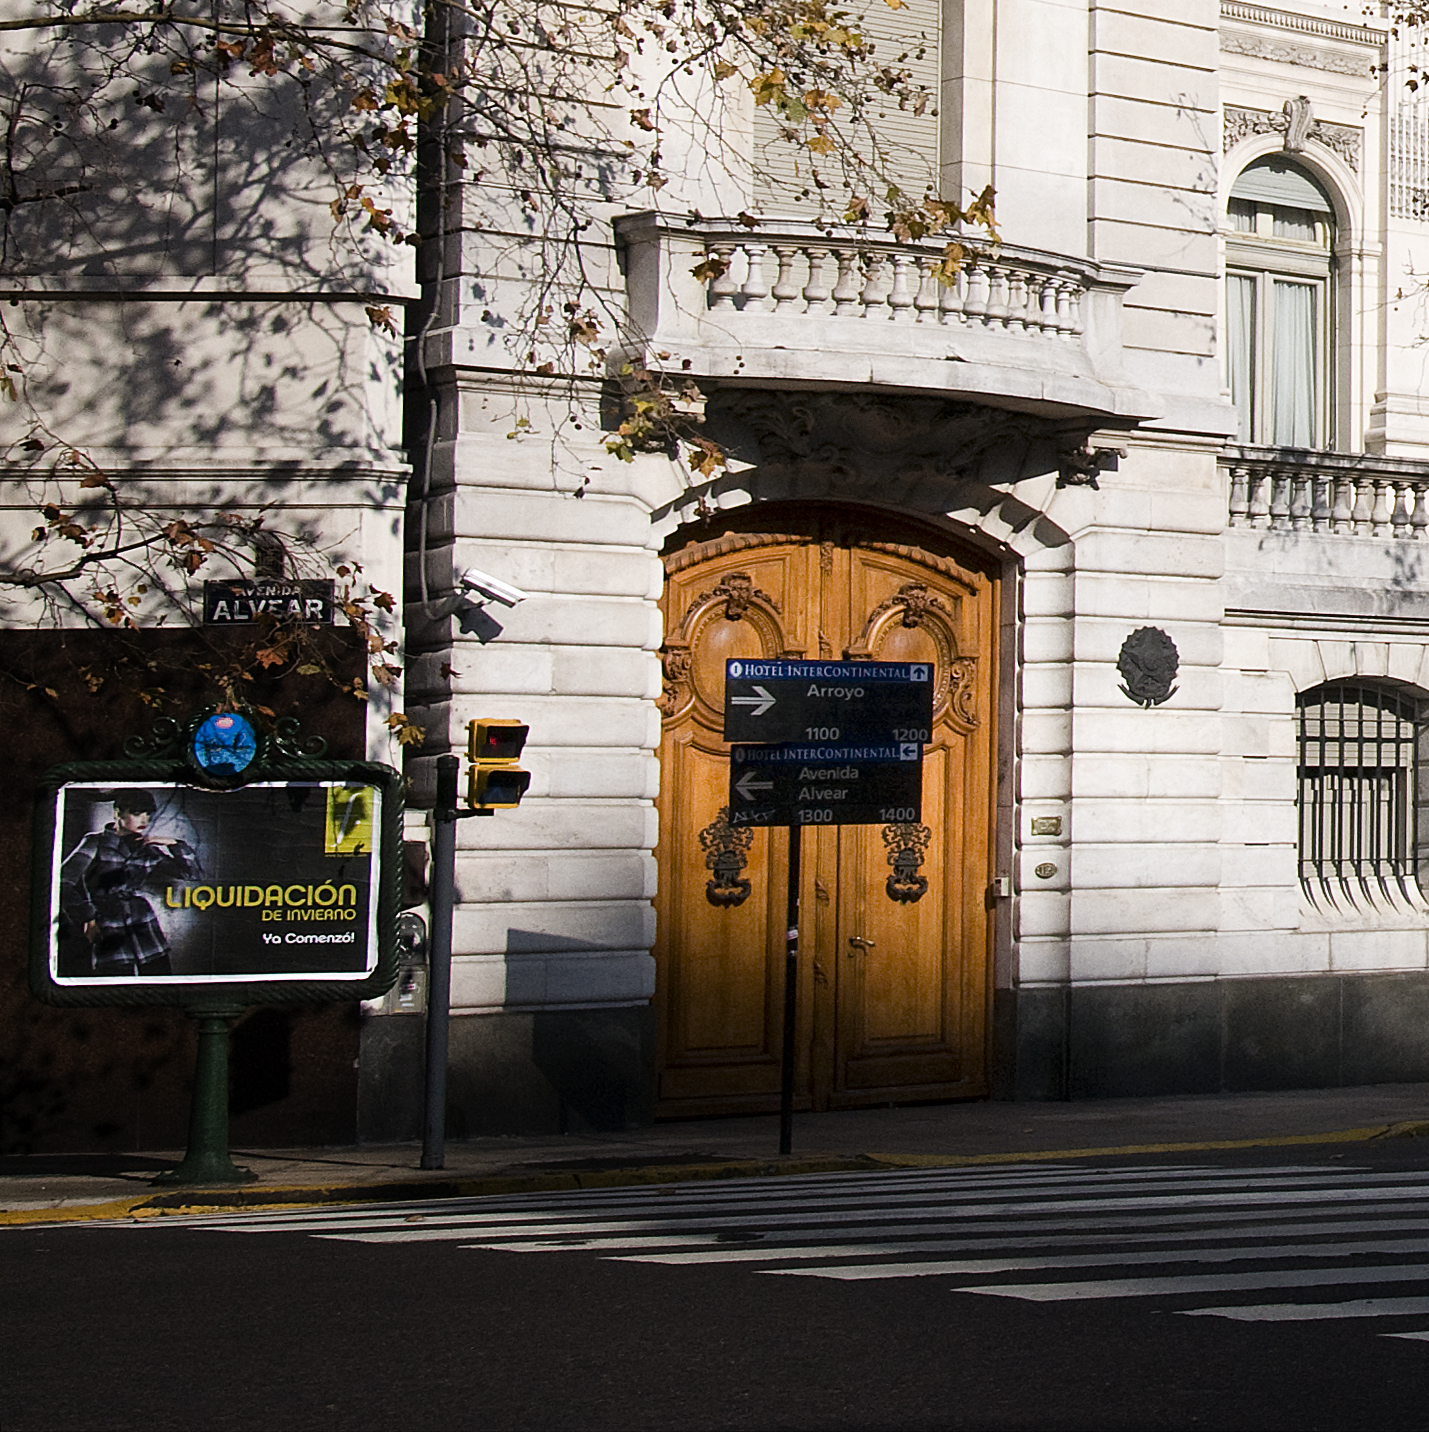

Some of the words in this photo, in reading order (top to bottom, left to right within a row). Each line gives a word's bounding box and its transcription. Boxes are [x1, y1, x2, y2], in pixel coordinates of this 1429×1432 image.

[212, 599, 323, 620] ALVEAR
[744, 663, 784, 676] HOTEL
[806, 684, 865, 701] Arroyo
[805, 727, 840, 740] 1100
[892, 728, 928, 742] 1200
[747, 748, 781, 761] HOTEL
[799, 765, 859, 780] Avenida
[798, 786, 848, 801] Alvear
[799, 809, 833, 823] 1300
[879, 807, 915, 822] 1400
[165, 879, 357, 911] LIQUIDACIÓN
[261, 909, 283, 922] DE
[286, 908, 357, 922] INVIERNO
[262, 932, 282, 945] Ya
[284, 931, 355, 945] Comenzó!
